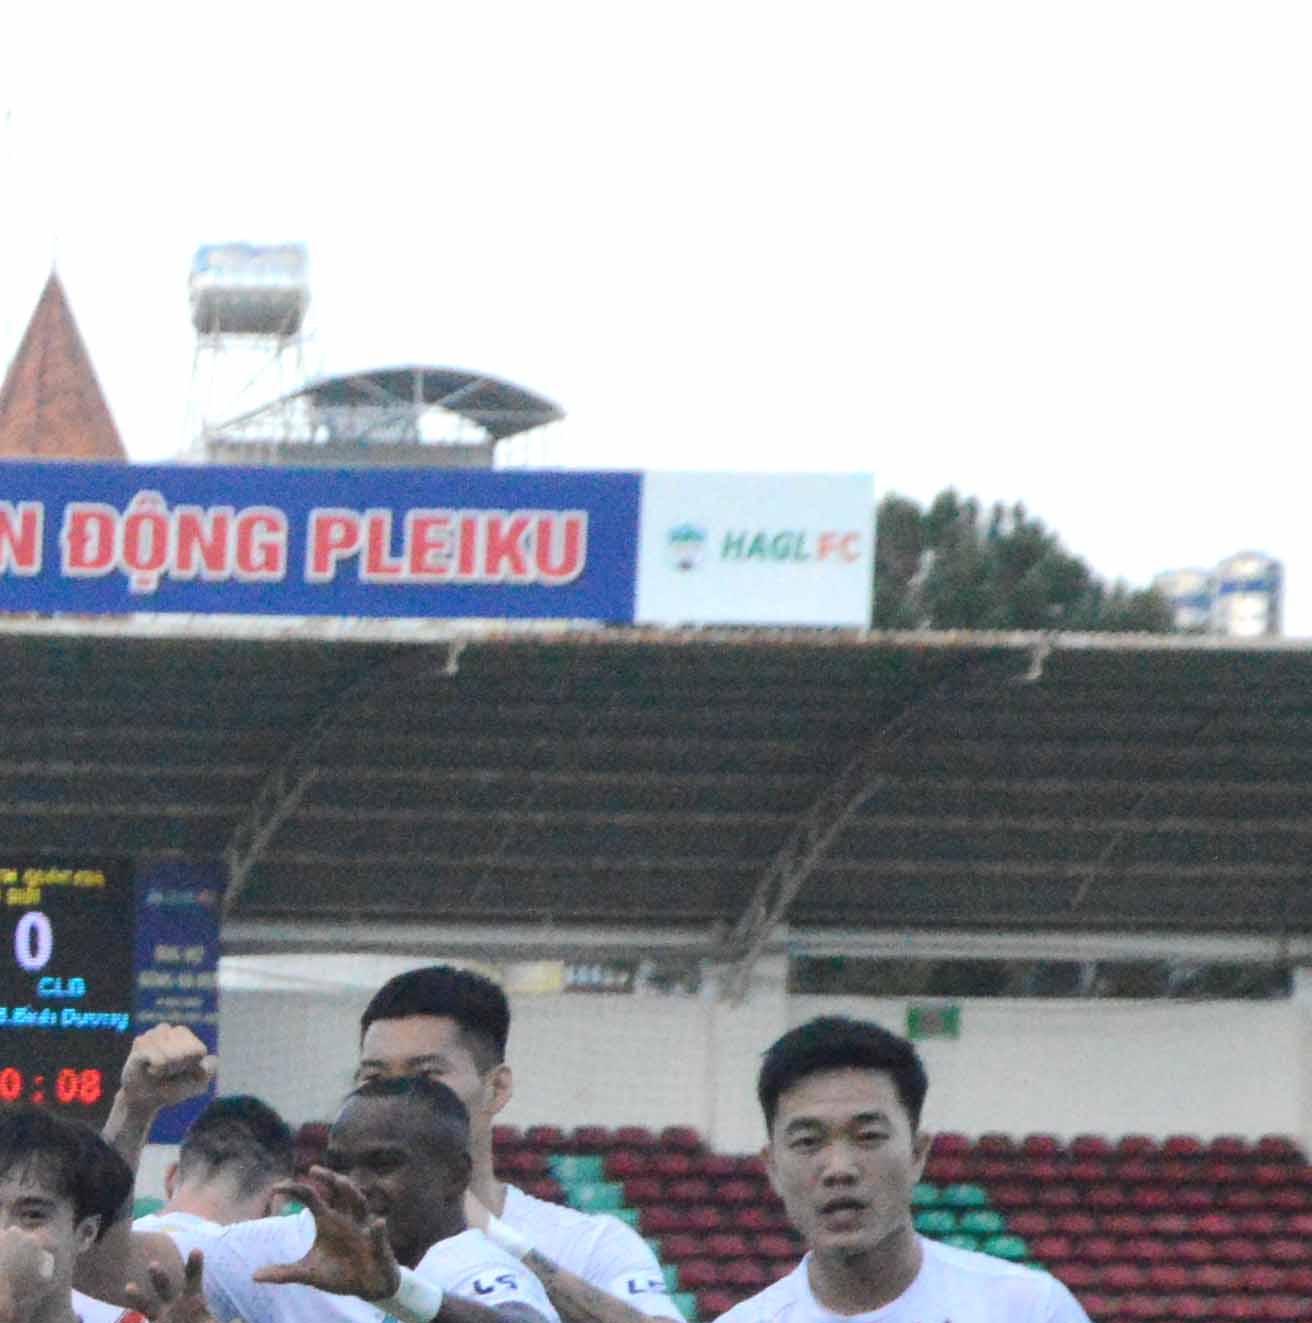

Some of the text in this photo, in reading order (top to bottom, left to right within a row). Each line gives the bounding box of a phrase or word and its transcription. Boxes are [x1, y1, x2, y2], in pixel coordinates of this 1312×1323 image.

[60, 489, 288, 595] ĐỘNG
[305, 506, 588, 586] PLEIKU
[721, 530, 862, 563] HAGL FC
[14, 910, 54, 972] 0
